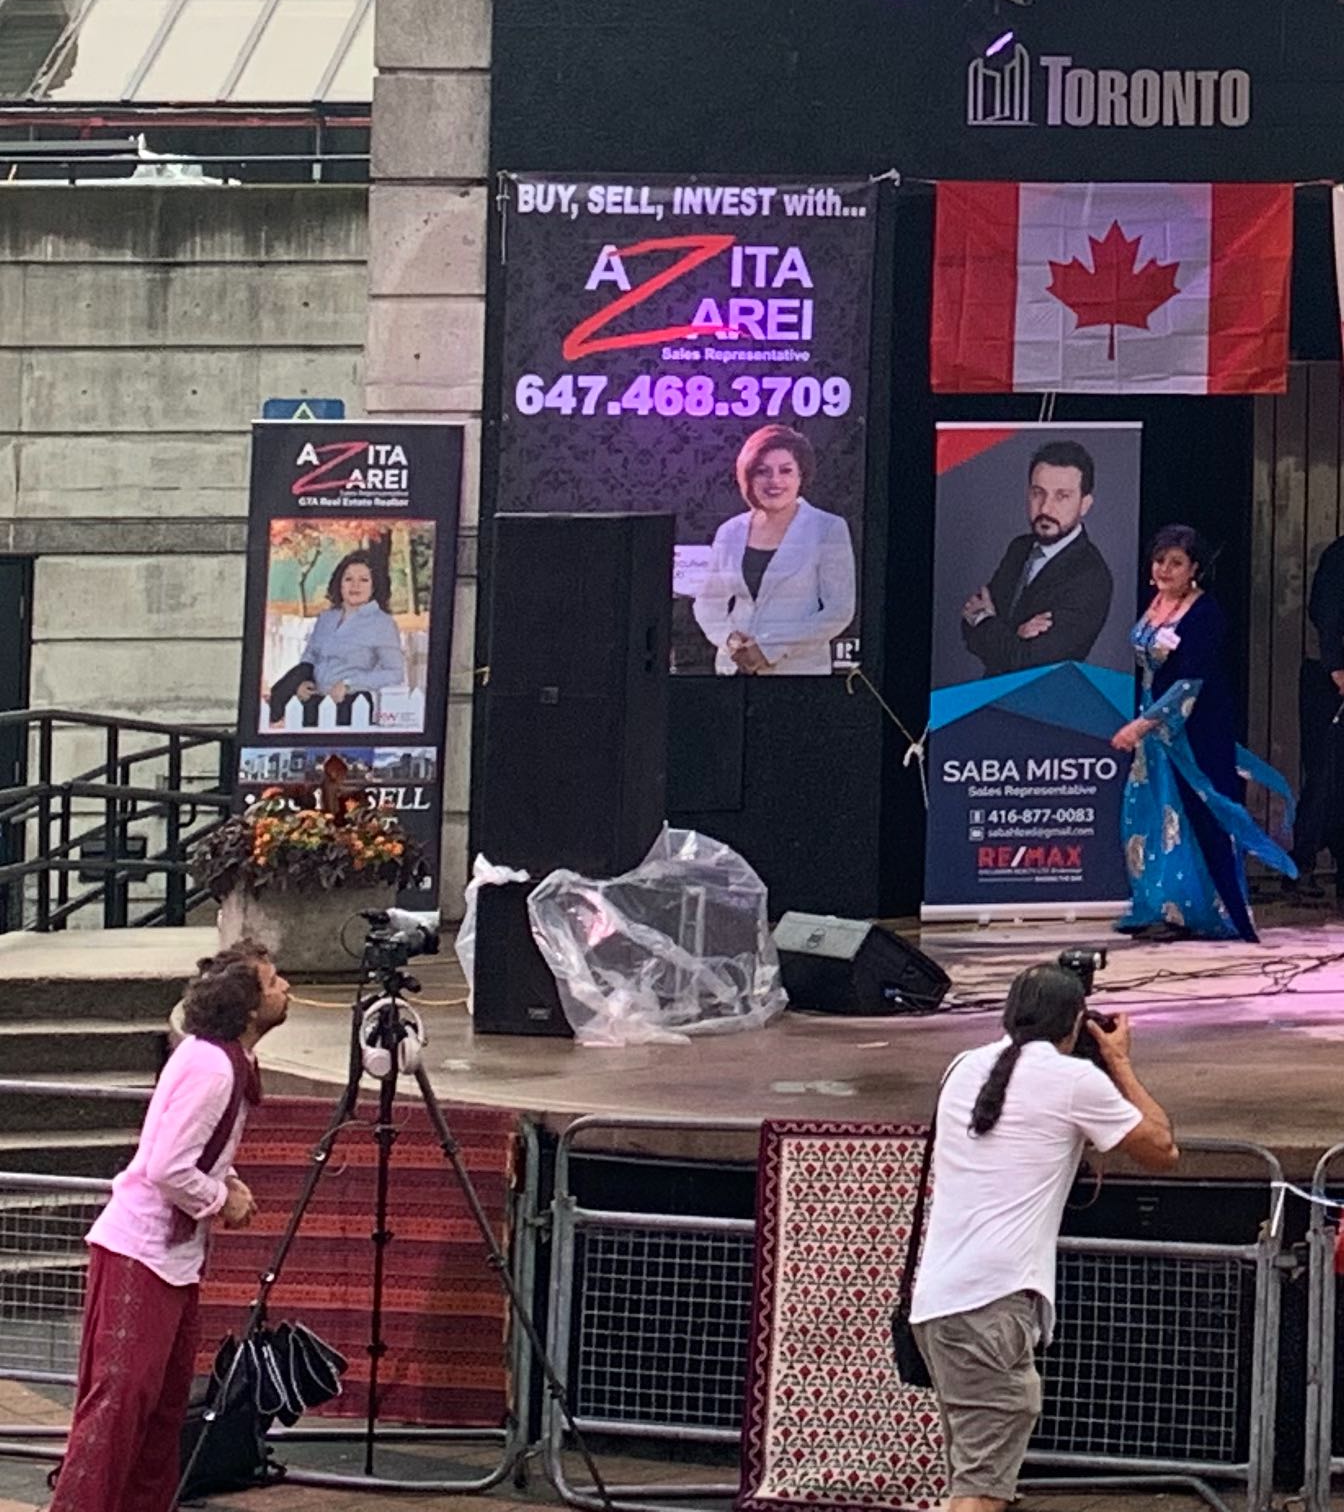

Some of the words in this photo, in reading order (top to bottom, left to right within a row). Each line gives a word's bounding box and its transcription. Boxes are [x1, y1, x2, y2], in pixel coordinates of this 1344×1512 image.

[1039, 55, 1250, 127] TORONTO
[517, 184, 579, 219] BUY,
[587, 186, 664, 220] SELL,
[672, 188, 777, 216] INVEST
[783, 188, 867, 218] with...
[661, 347, 701, 362] Sales
[704, 348, 811, 364] Representative
[514, 374, 852, 418] 647.468.3709
[942, 759, 1020, 783] SABA
[1026, 757, 1118, 781] MISTO
[365, 787, 431, 810] SELL
[968, 785, 1002, 798] Sales
[1004, 784, 1098, 798] Representative
[987, 807, 1095, 824] 416-877-0083
[977, 845, 1082, 868] RE/MAX
